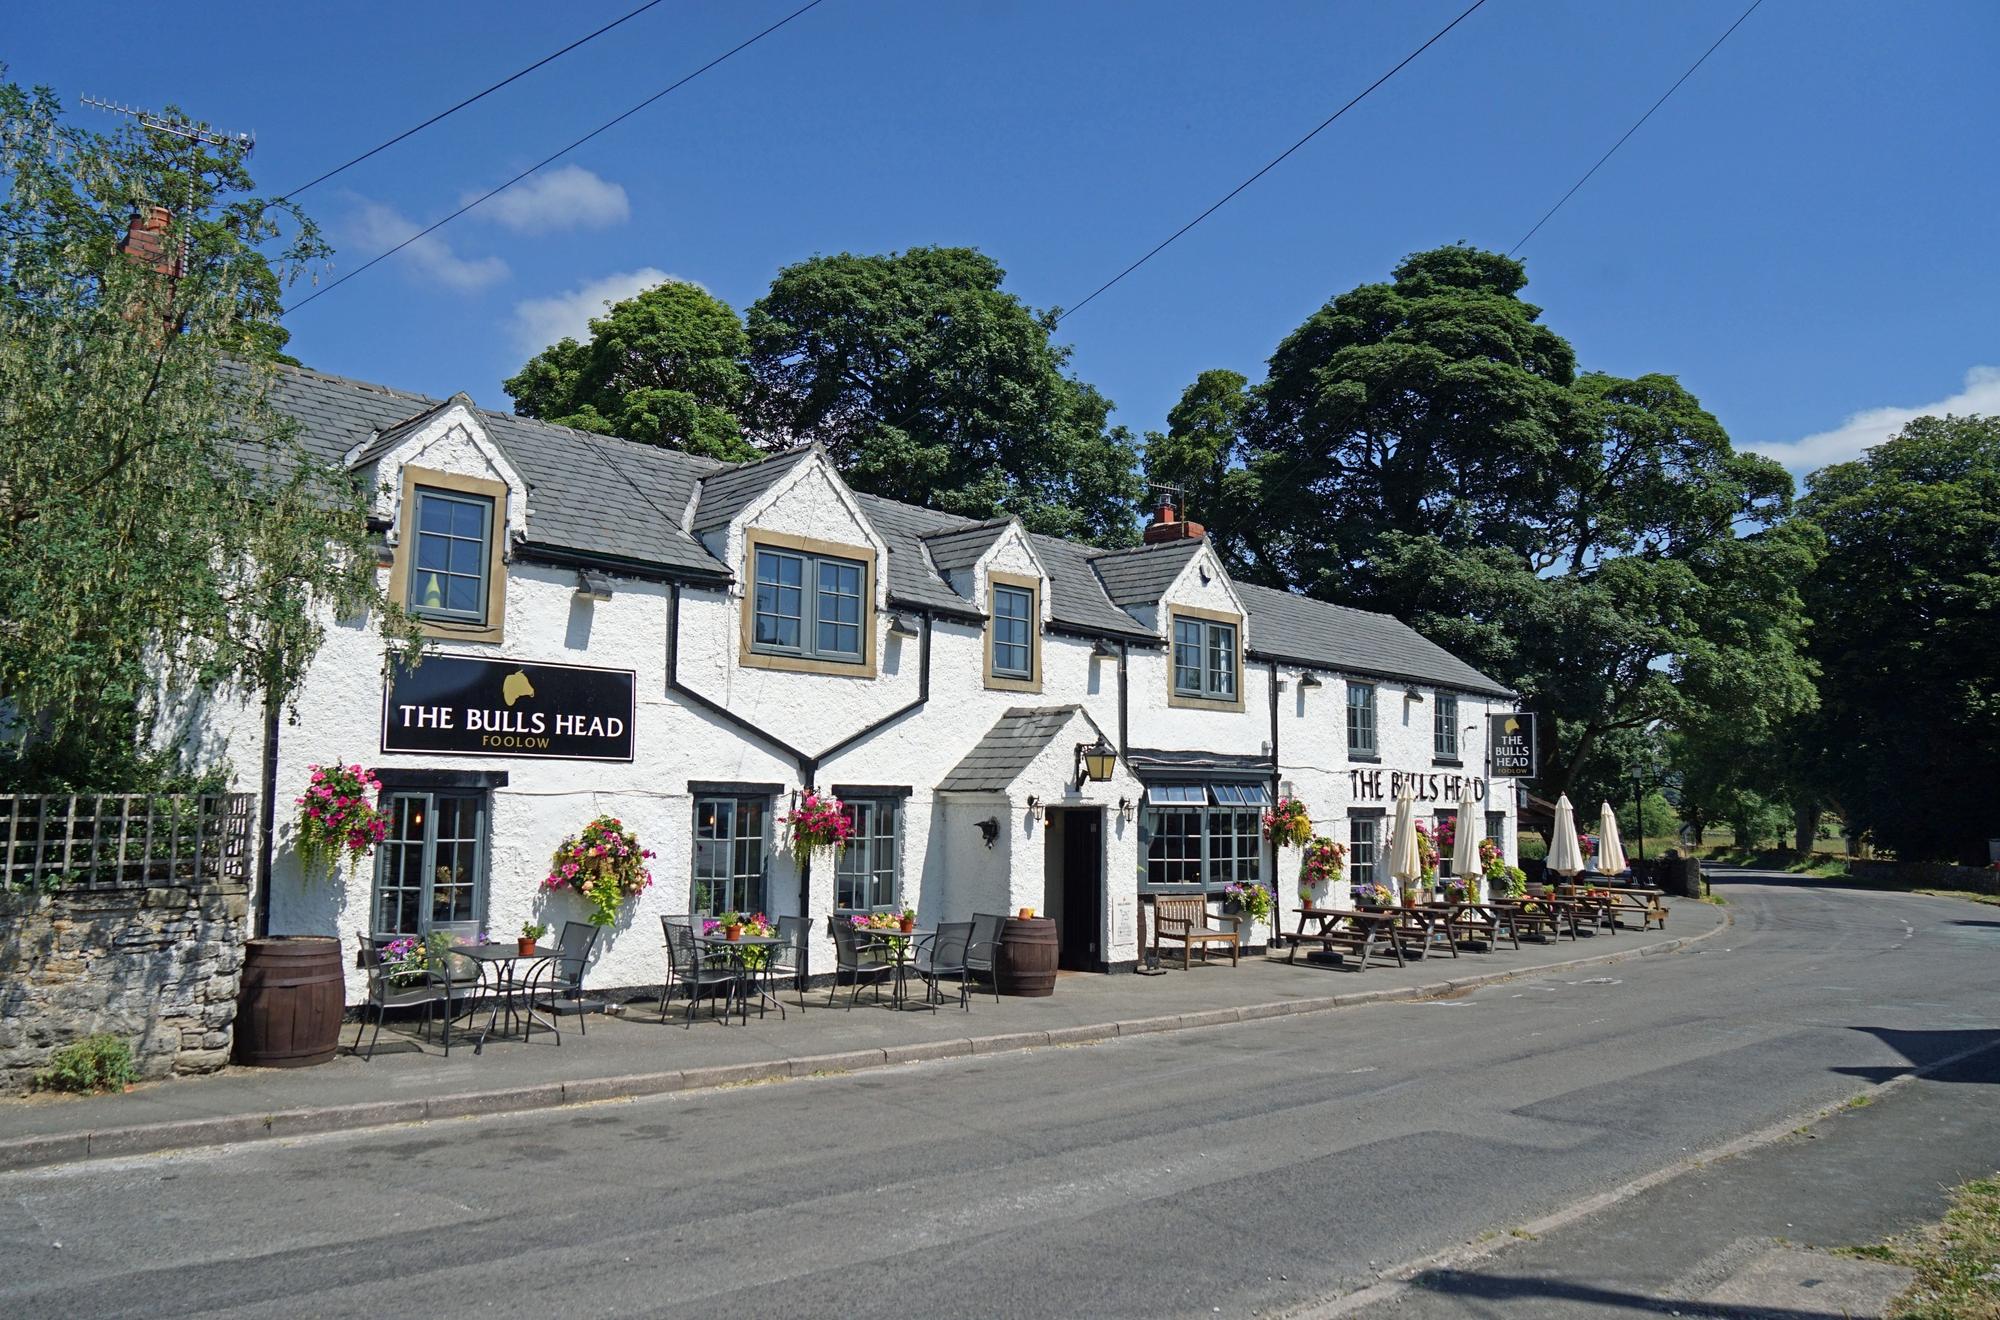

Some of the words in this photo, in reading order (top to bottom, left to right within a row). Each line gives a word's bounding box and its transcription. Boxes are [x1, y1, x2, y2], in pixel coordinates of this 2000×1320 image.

[400, 705, 454, 729] THE
[466, 708, 545, 734] BULLS
[555, 714, 624, 737] HEAD
[482, 735, 550, 749] FOOLOW
[1501, 735, 1523, 745] THE
[1495, 746, 1529, 756] BULLS
[1496, 757, 1529, 767] HEAD
[1350, 770, 1384, 799] THE
